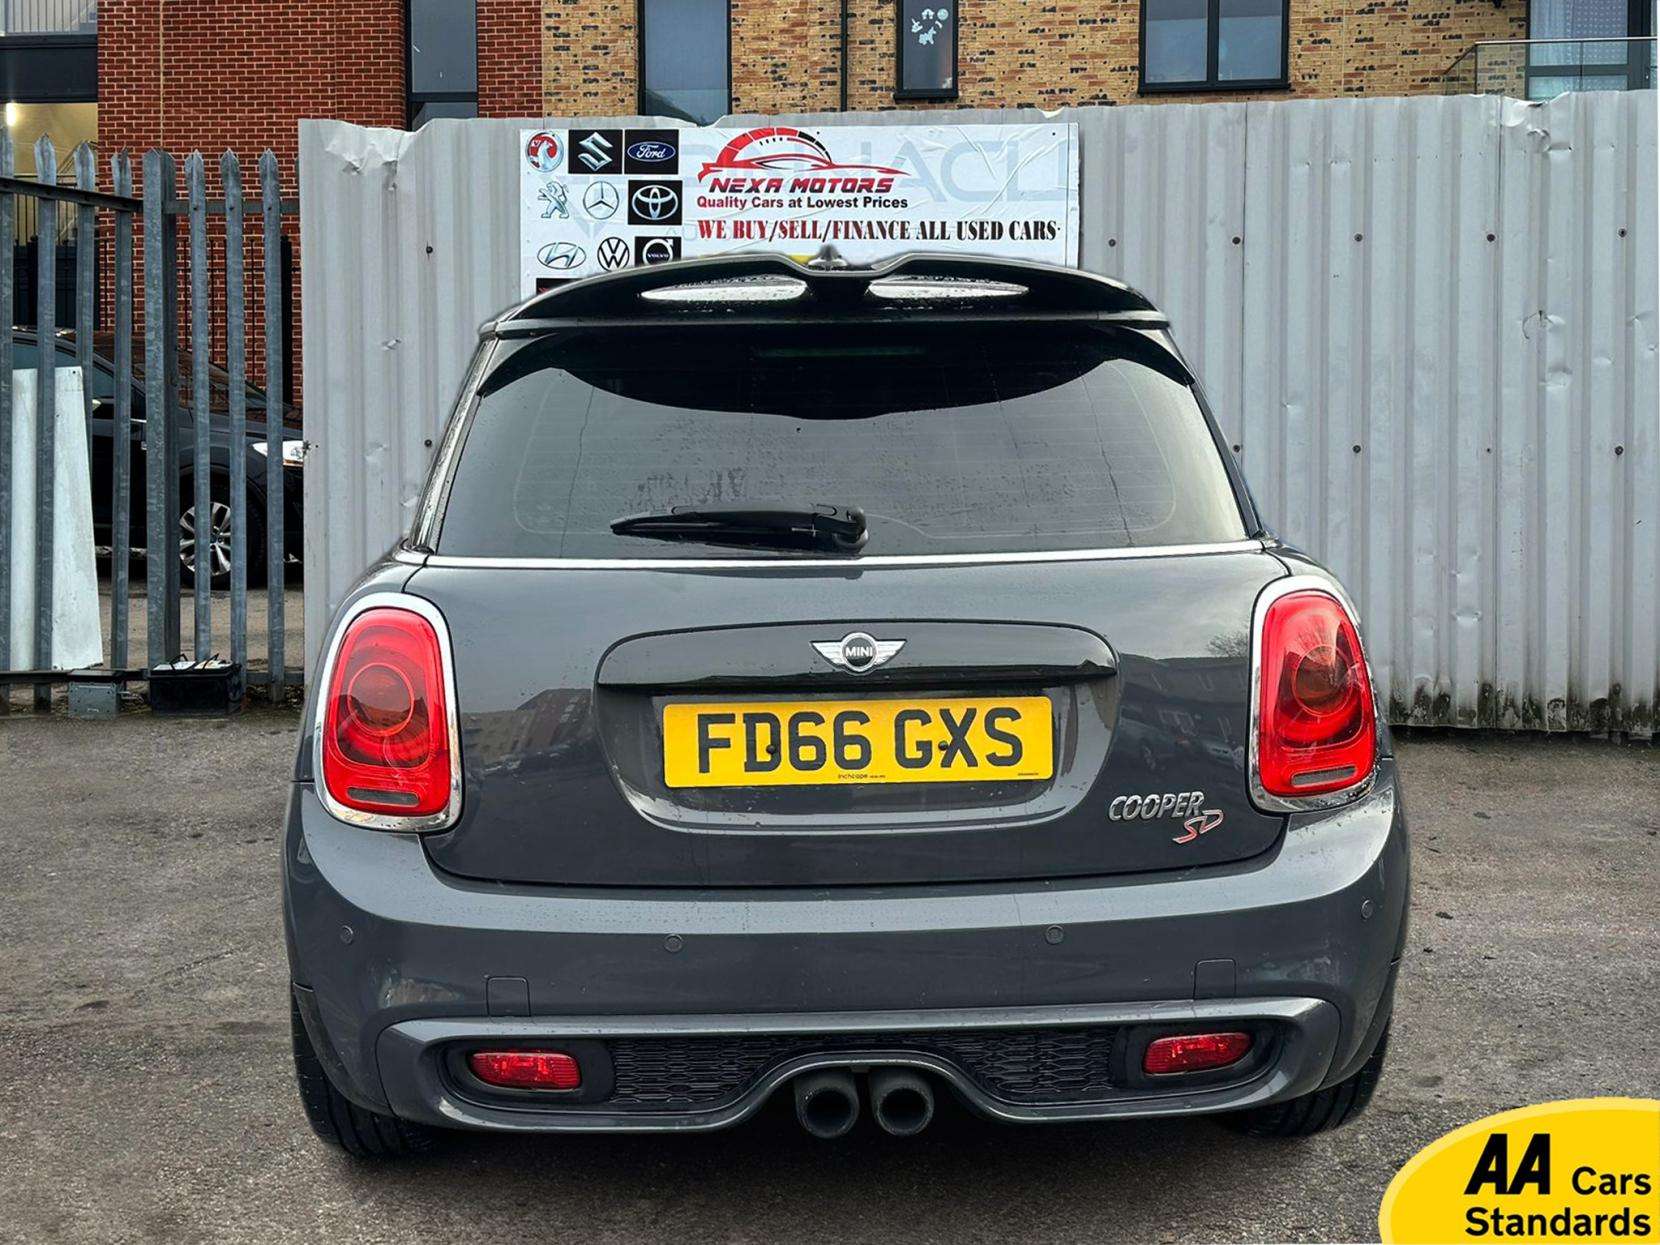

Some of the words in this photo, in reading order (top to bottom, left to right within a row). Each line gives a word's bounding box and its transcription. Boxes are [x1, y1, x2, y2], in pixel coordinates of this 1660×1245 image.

[636, 144, 666, 159] Ford
[709, 178, 784, 193] NEXA
[789, 178, 894, 193] MOTORS
[697, 196, 747, 210] Quality
[752, 197, 784, 208] Cars
[788, 197, 803, 208] at
[807, 196, 859, 208] Lowest
[863, 196, 908, 208] Prices
[697, 219, 727, 239] WE
[733, 219, 911, 243] BUY/SELL/FINANCE
[916, 220, 951, 240] ALL
[956, 220, 1004, 240] USED
[845, 646, 873, 657] MINI
[697, 711, 872, 773] FD66
[894, 707, 1023, 769] GXS
[1108, 791, 1205, 821] COOPER
[1172, 809, 1224, 844] SD
